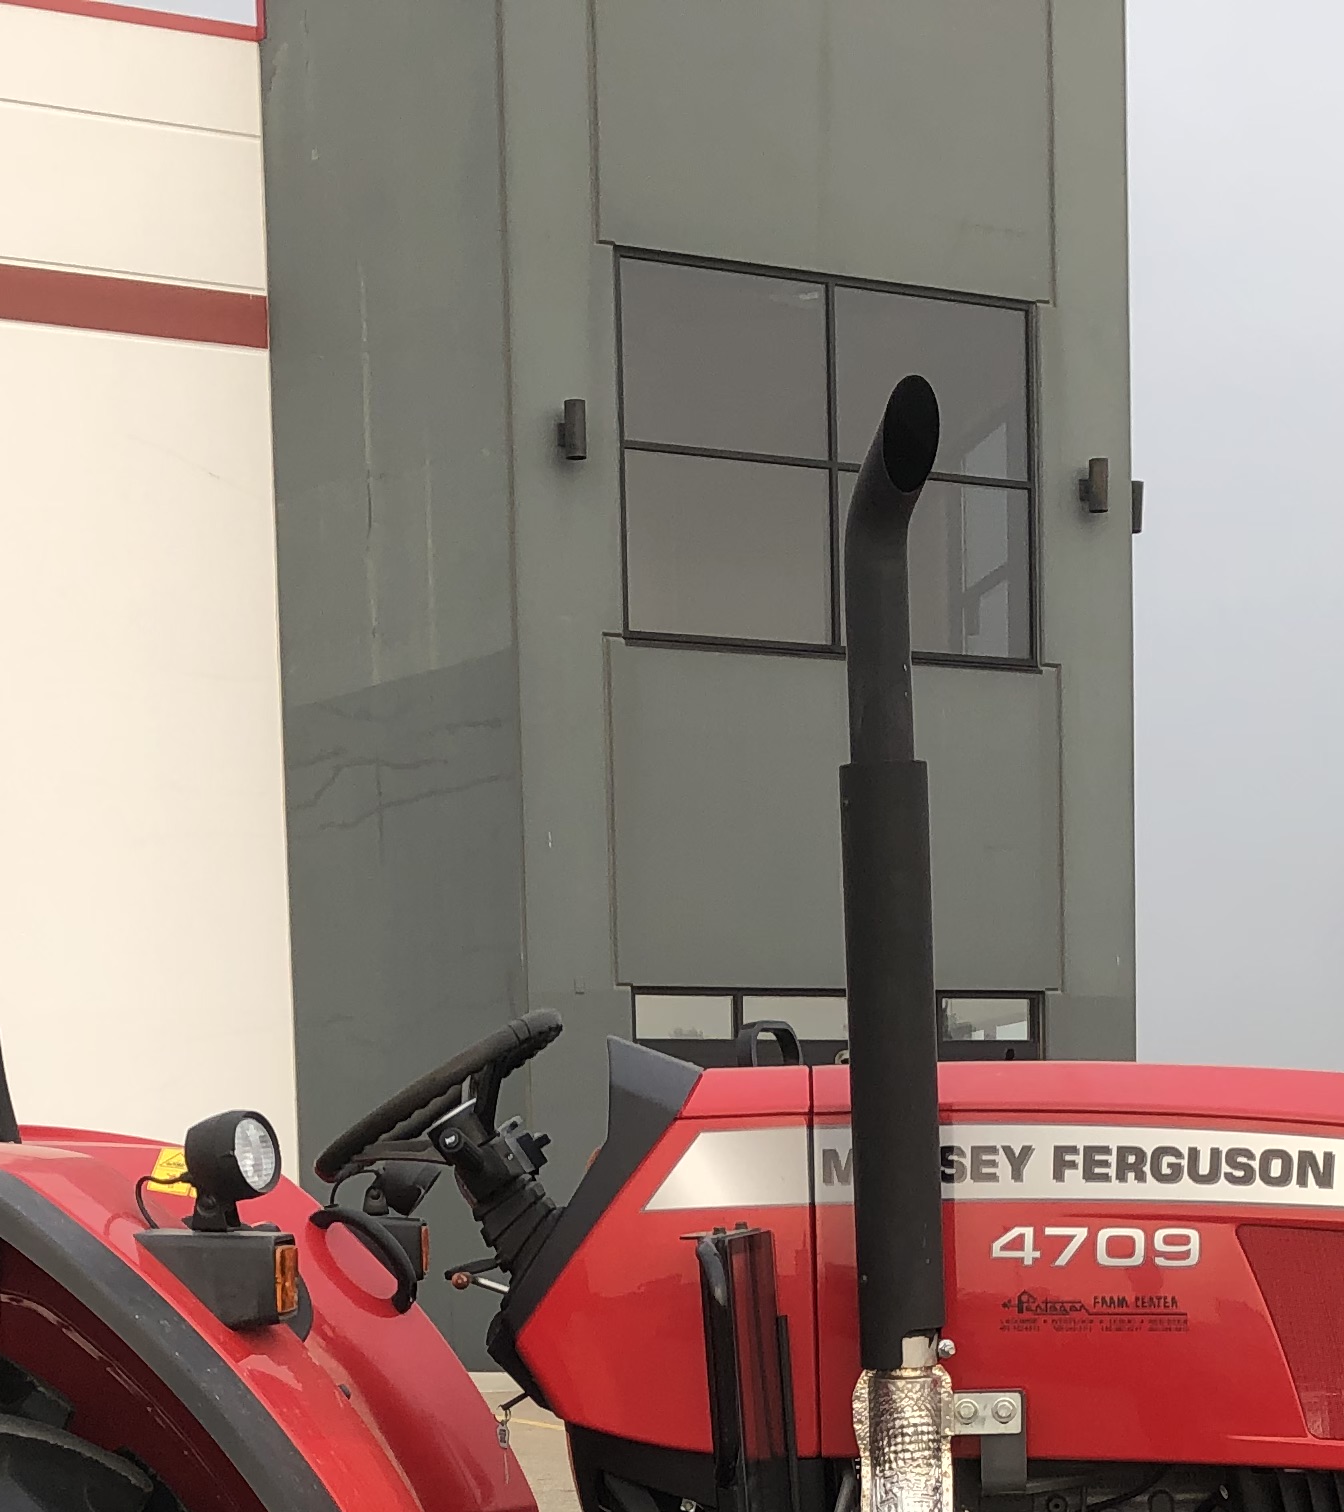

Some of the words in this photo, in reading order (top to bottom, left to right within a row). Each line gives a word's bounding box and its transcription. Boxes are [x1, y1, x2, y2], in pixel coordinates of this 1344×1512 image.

[821, 1144, 1036, 1187] MSEY
[1052, 1144, 1336, 1190] FERGUSON
[990, 1226, 1201, 1269] 4709
